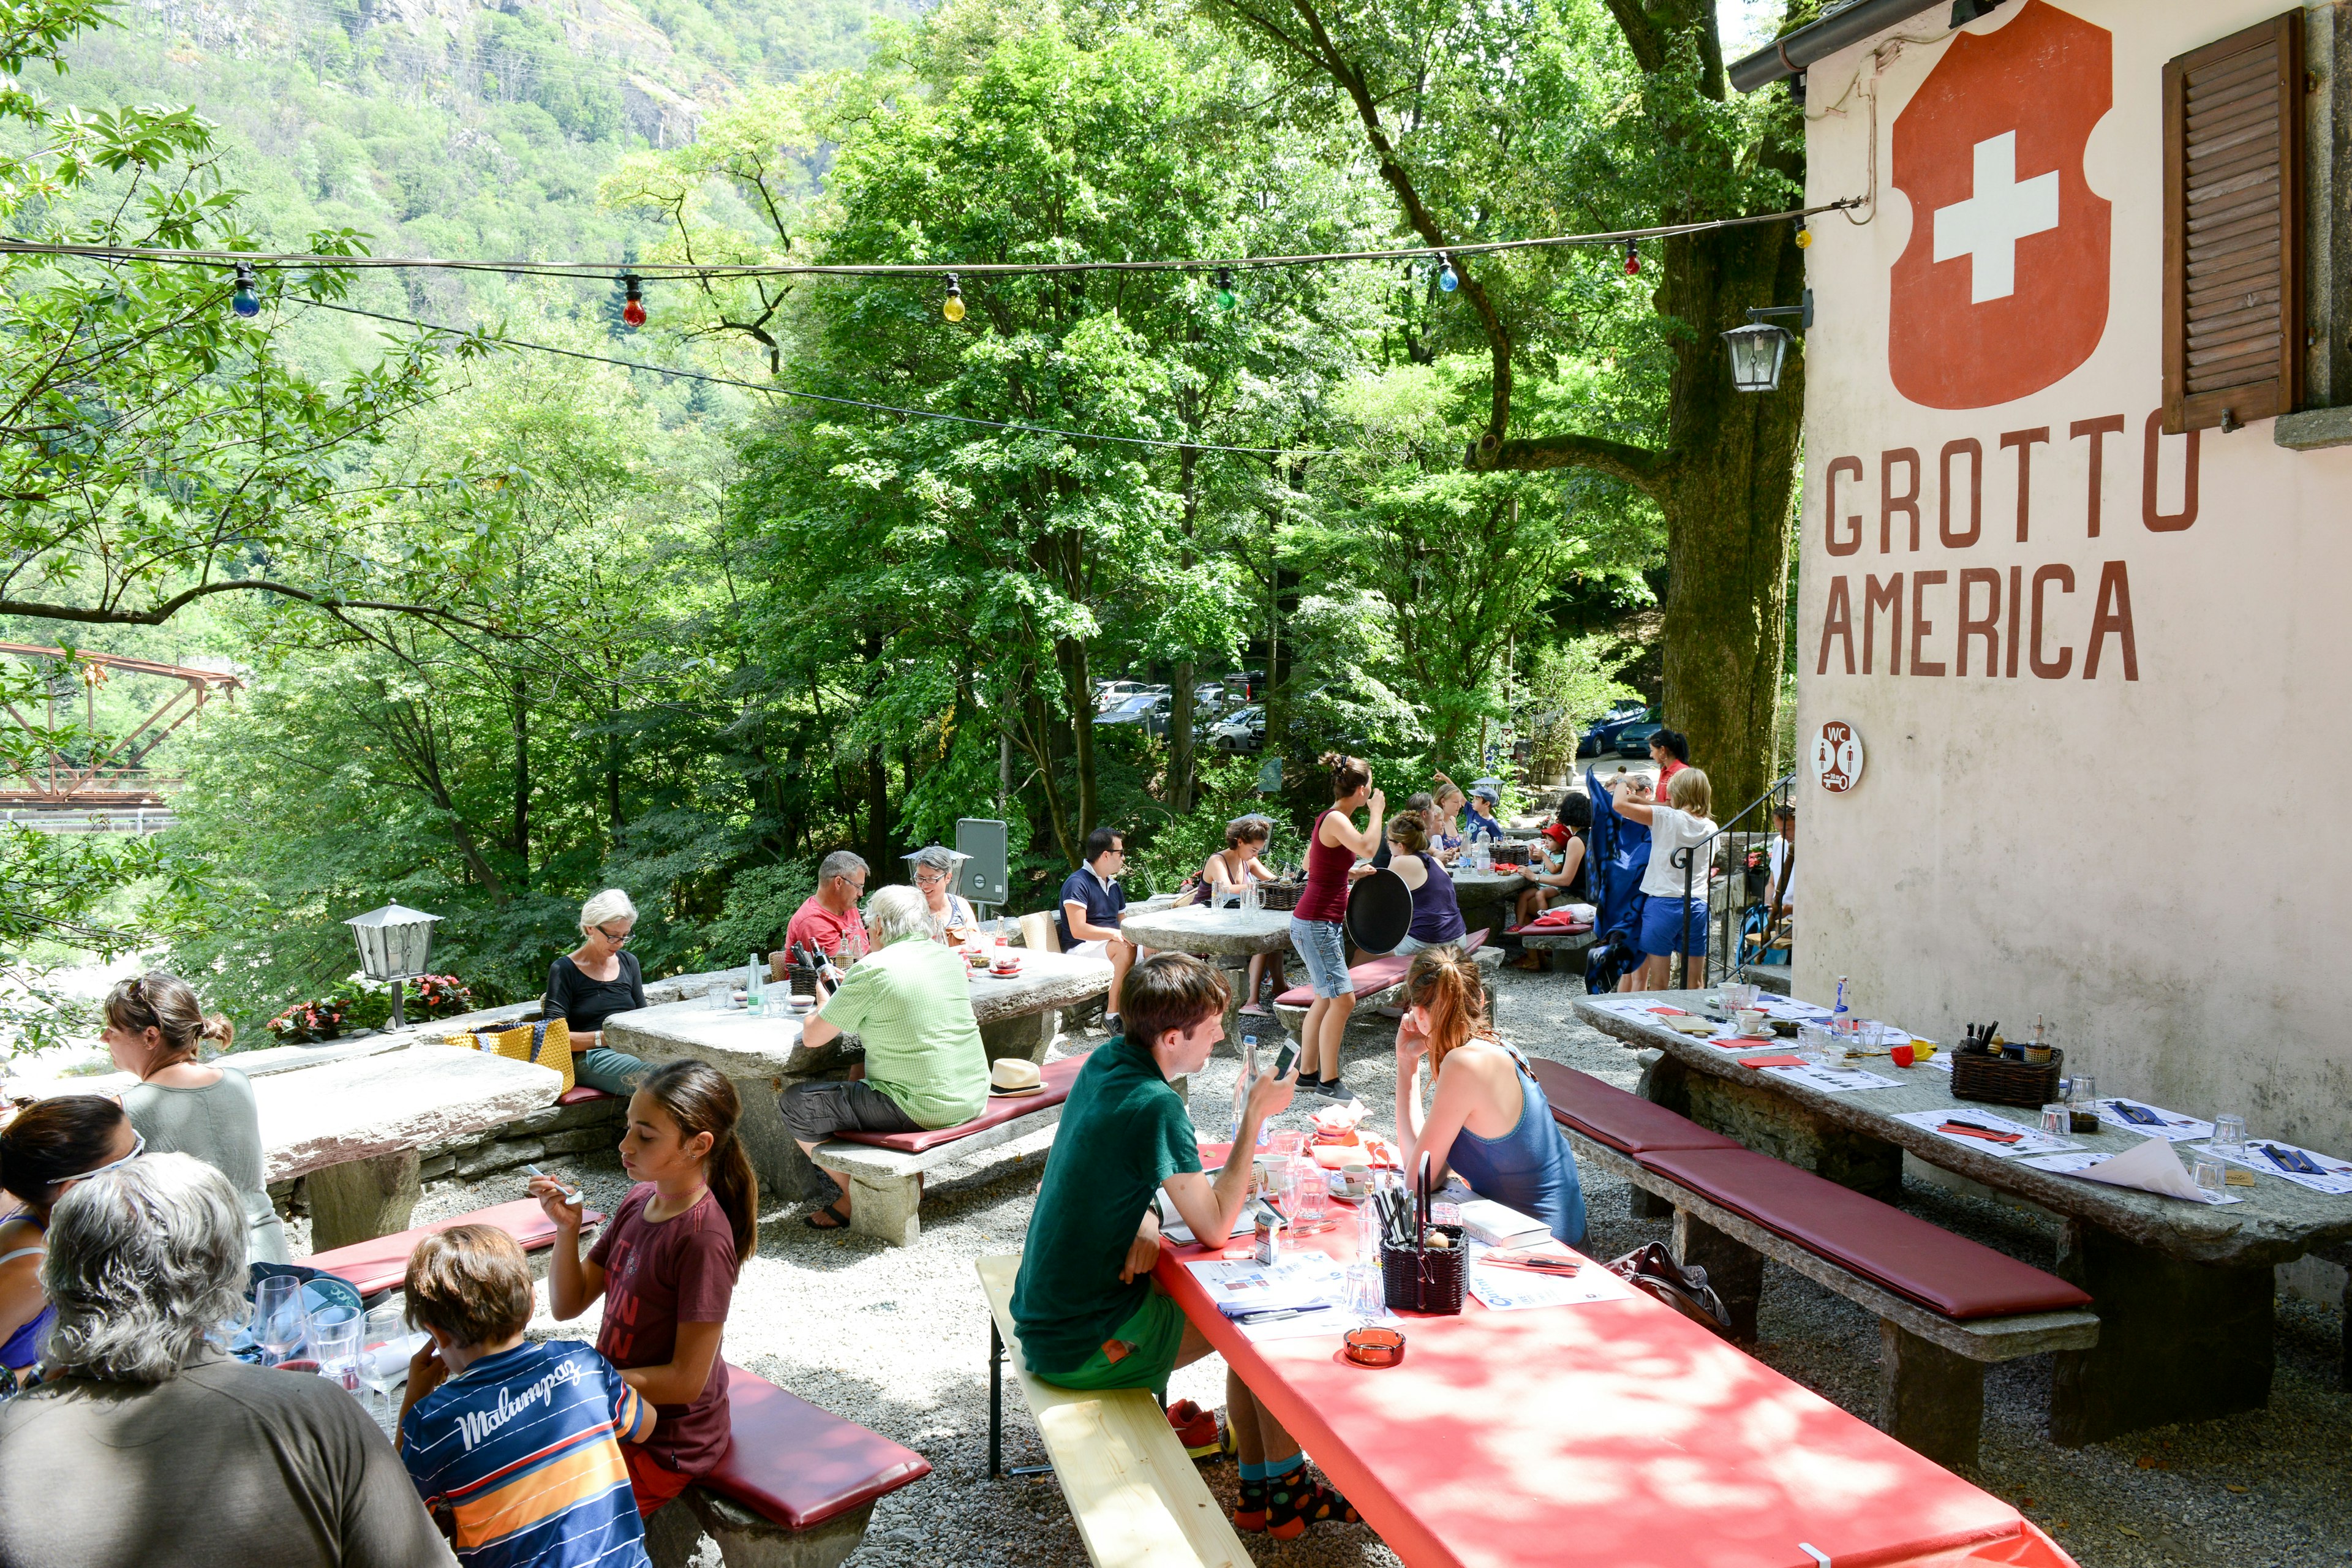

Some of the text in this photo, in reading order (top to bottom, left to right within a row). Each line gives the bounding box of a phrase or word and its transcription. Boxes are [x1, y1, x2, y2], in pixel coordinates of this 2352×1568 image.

[1825, 407, 2200, 557] GROTTO
[1817, 560, 2139, 681] AMERICA
[1827, 726, 1846, 742] WC
[454, 1360, 582, 1452] Malumpaz
